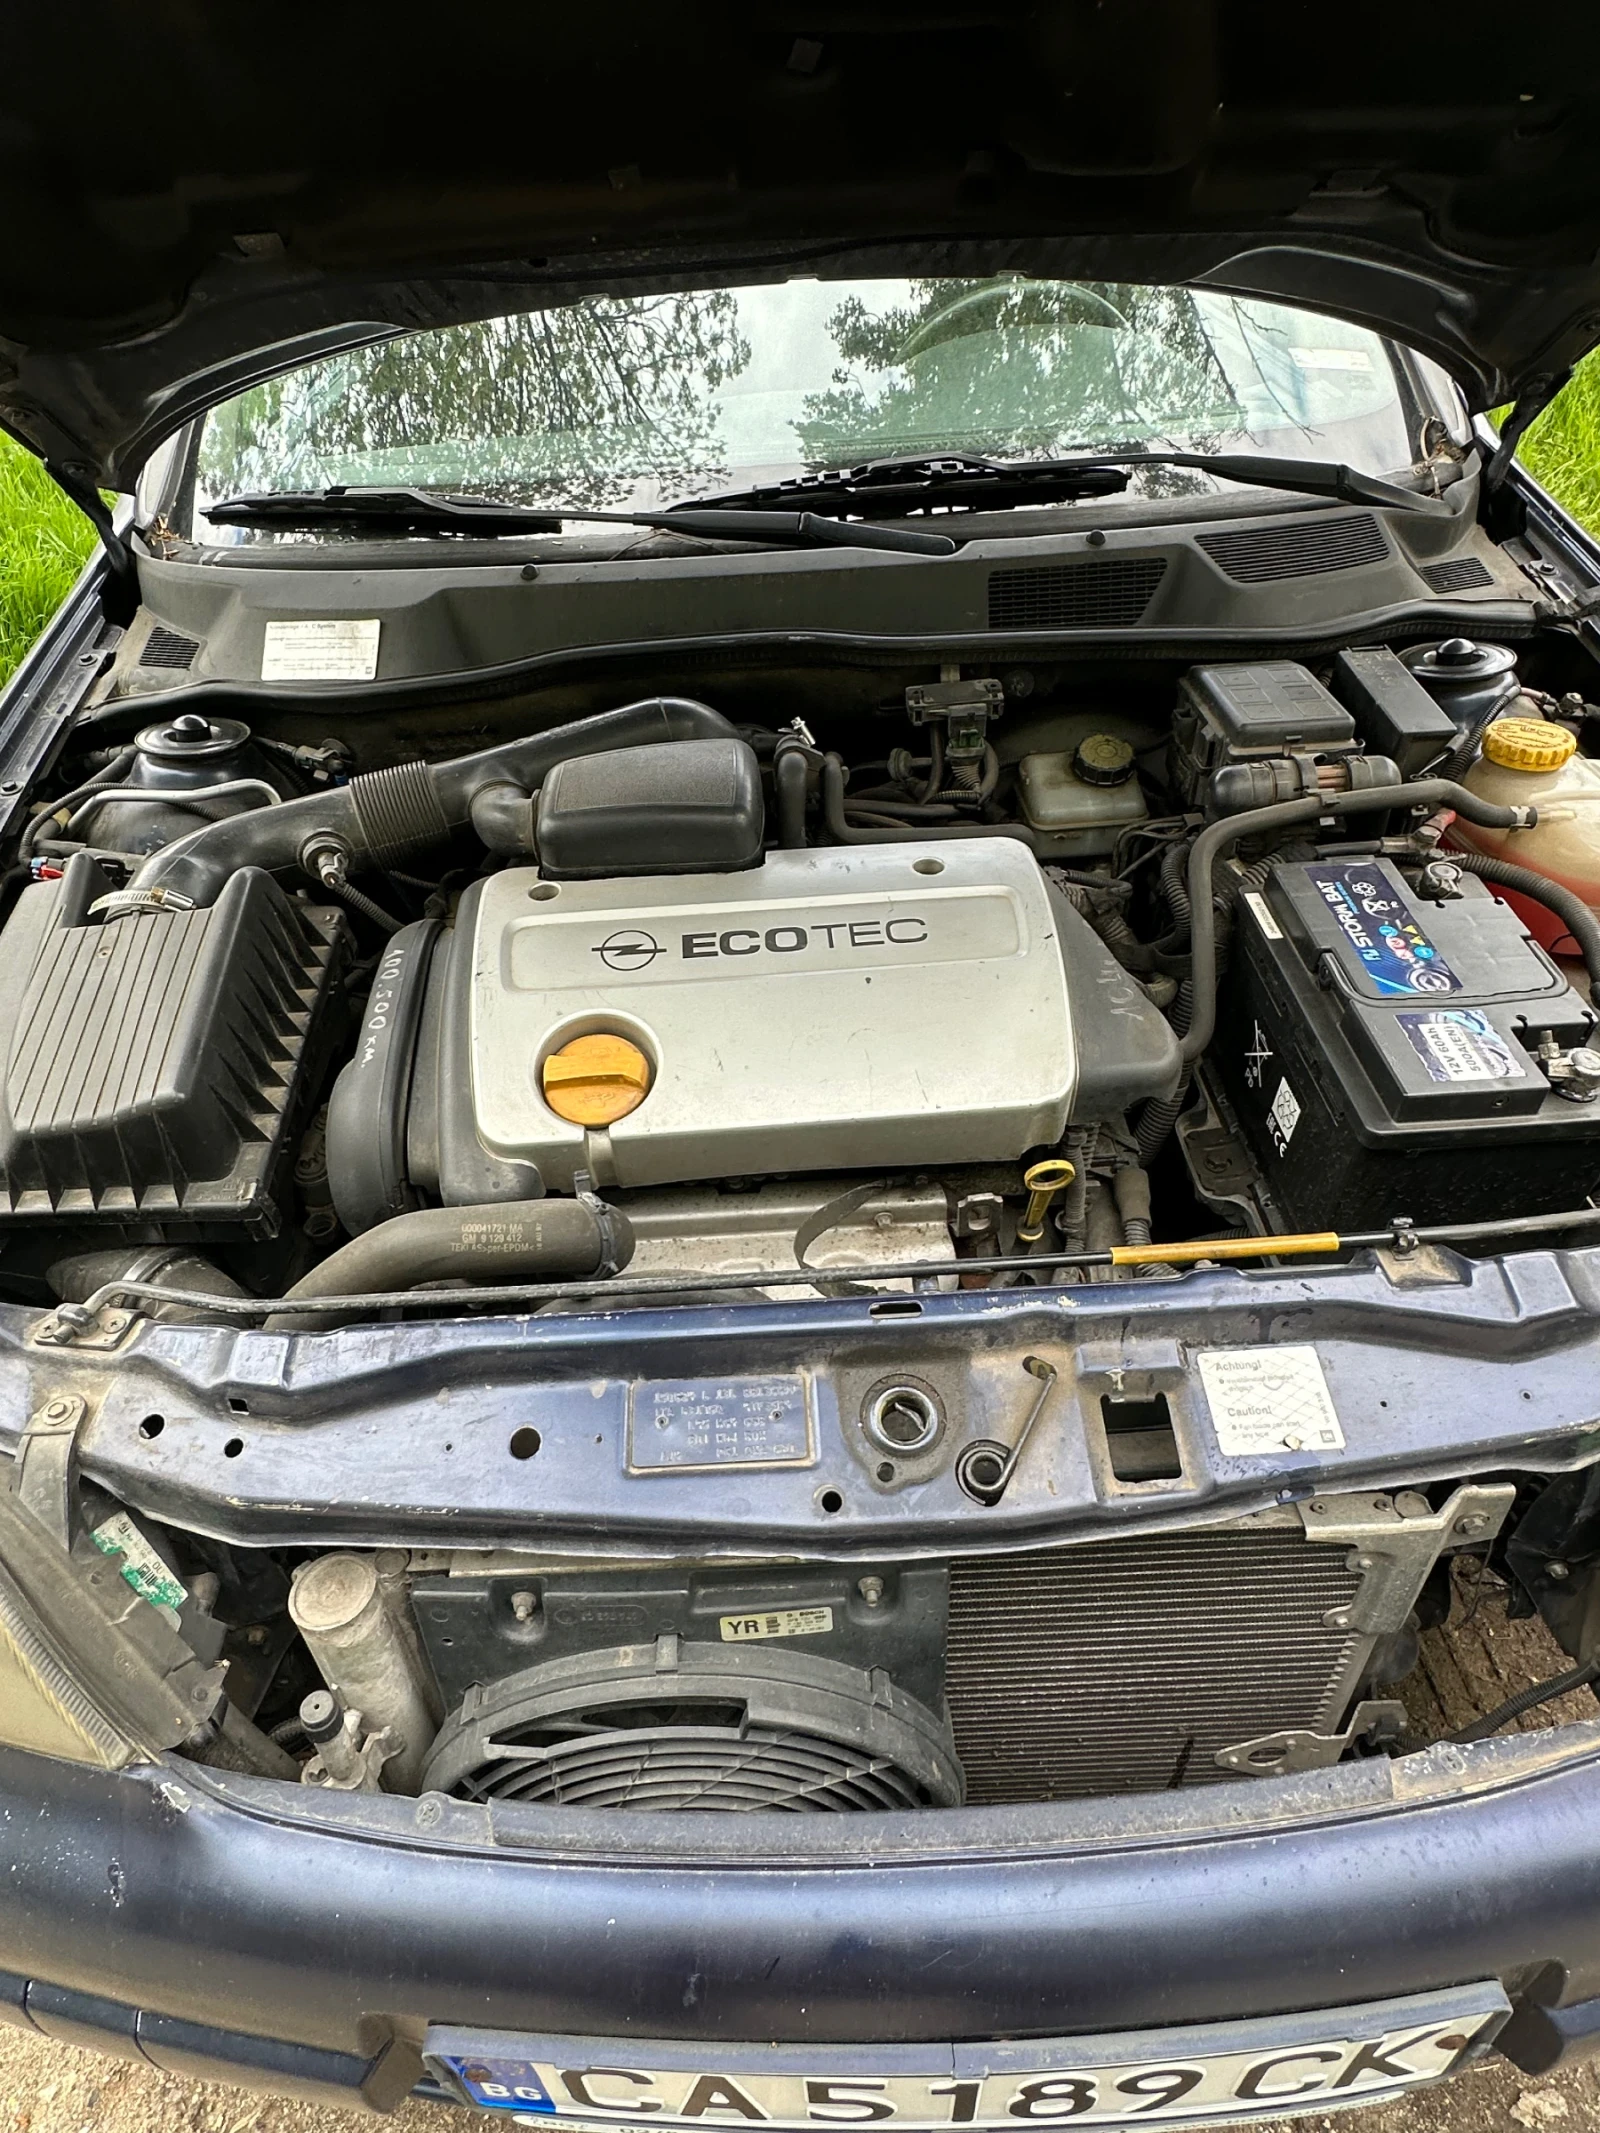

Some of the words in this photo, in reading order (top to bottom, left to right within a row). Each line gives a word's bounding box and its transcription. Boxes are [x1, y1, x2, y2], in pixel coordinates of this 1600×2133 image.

[1316, 880, 1346, 905] BAT
[1333, 904, 1373, 949] STORM
[682, 918, 928, 959] ECOTEC
[1426, 1026, 1453, 1053] 60Ah
[1444, 1052, 1465, 1075] 12V
[462, 1233, 477, 1244] GM
[480, 1234, 487, 1243] 9
[488, 1234, 505, 1243] 129
[506, 1233, 522, 1243] 412
[1216, 1360, 1262, 1372] Achtung!
[1227, 1405, 1272, 1417] Caution!
[728, 1619, 760, 1635] YR
[561, 2069, 769, 2121] CA
[805, 2069, 1204, 2122] 5189
[1236, 2026, 1451, 2099] CK
[479, 2081, 542, 2101] BG
